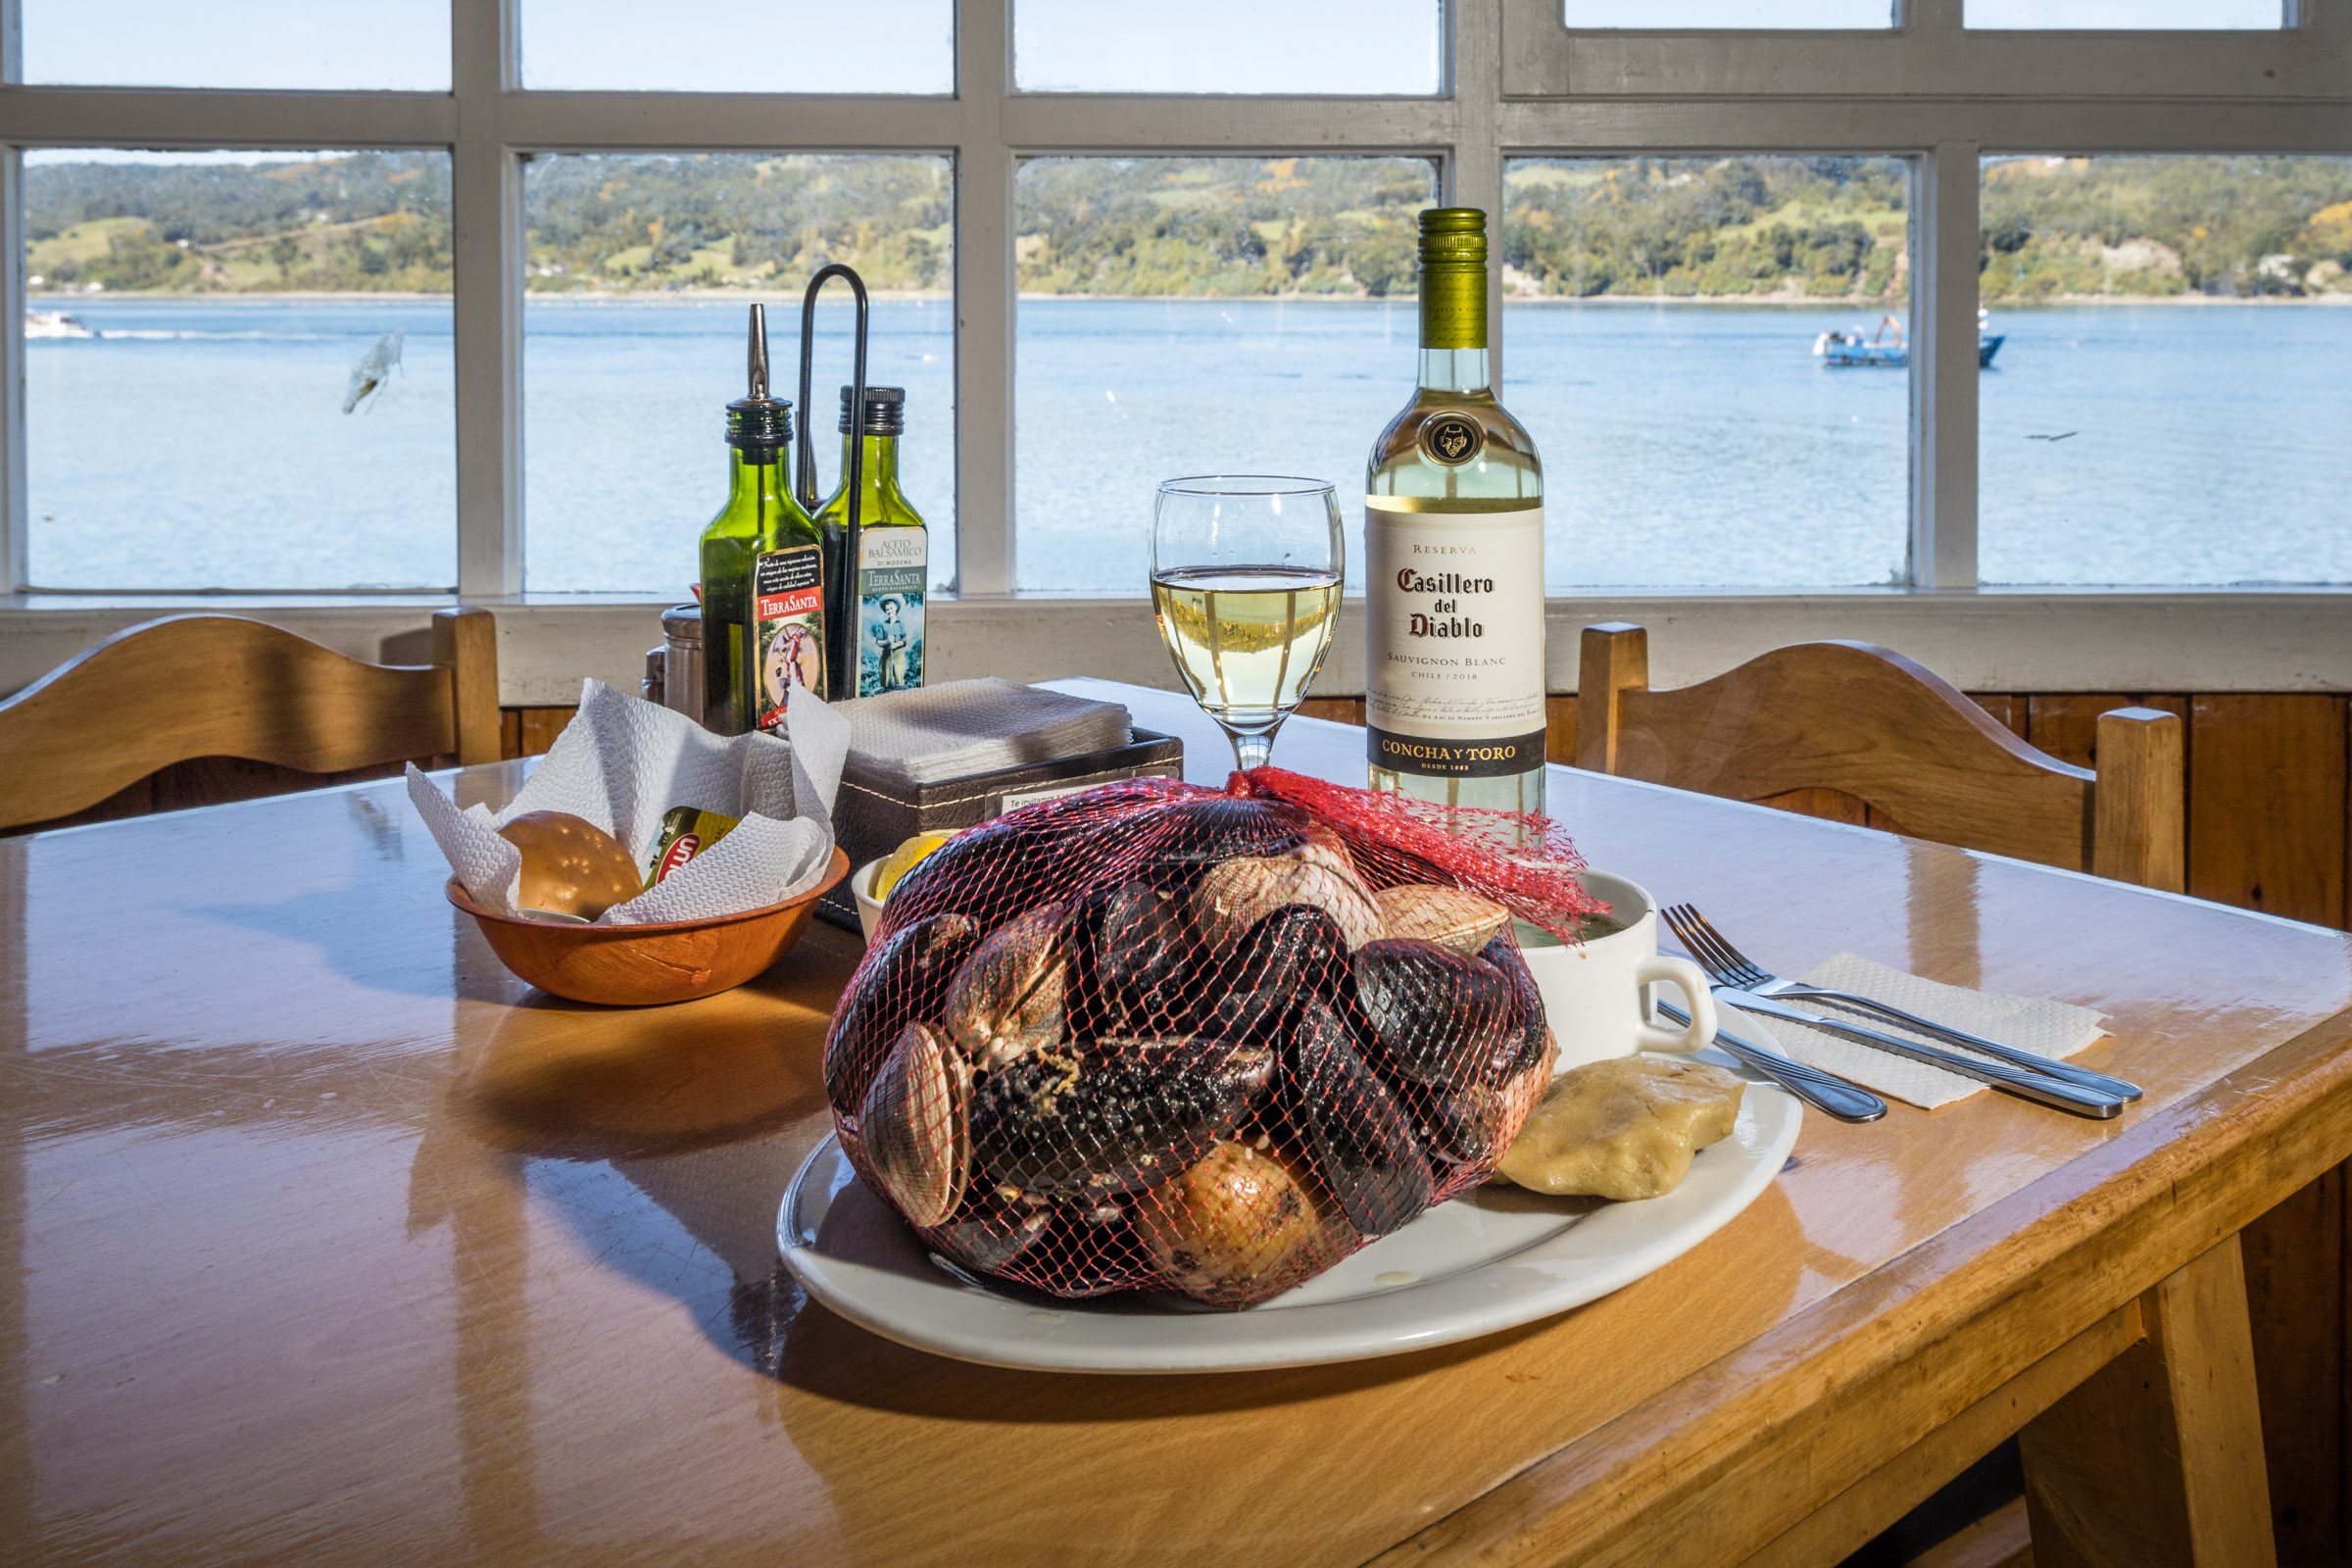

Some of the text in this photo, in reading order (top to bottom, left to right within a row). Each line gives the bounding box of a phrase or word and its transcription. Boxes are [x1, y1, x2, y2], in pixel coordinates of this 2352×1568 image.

[882, 539, 911, 550] ACETO
[1412, 544, 1477, 555] RESERVA
[868, 547, 923, 559] BALSAMICO
[1396, 567, 1495, 594] Casillero
[1434, 599, 1458, 614] del
[1409, 612, 1485, 639] Diablo
[1388, 652, 1506, 667] SAUVIGNON BLANC
[1411, 671, 1443, 680] CHILE
[1382, 739, 1516, 760] CONCHA Y TORO
